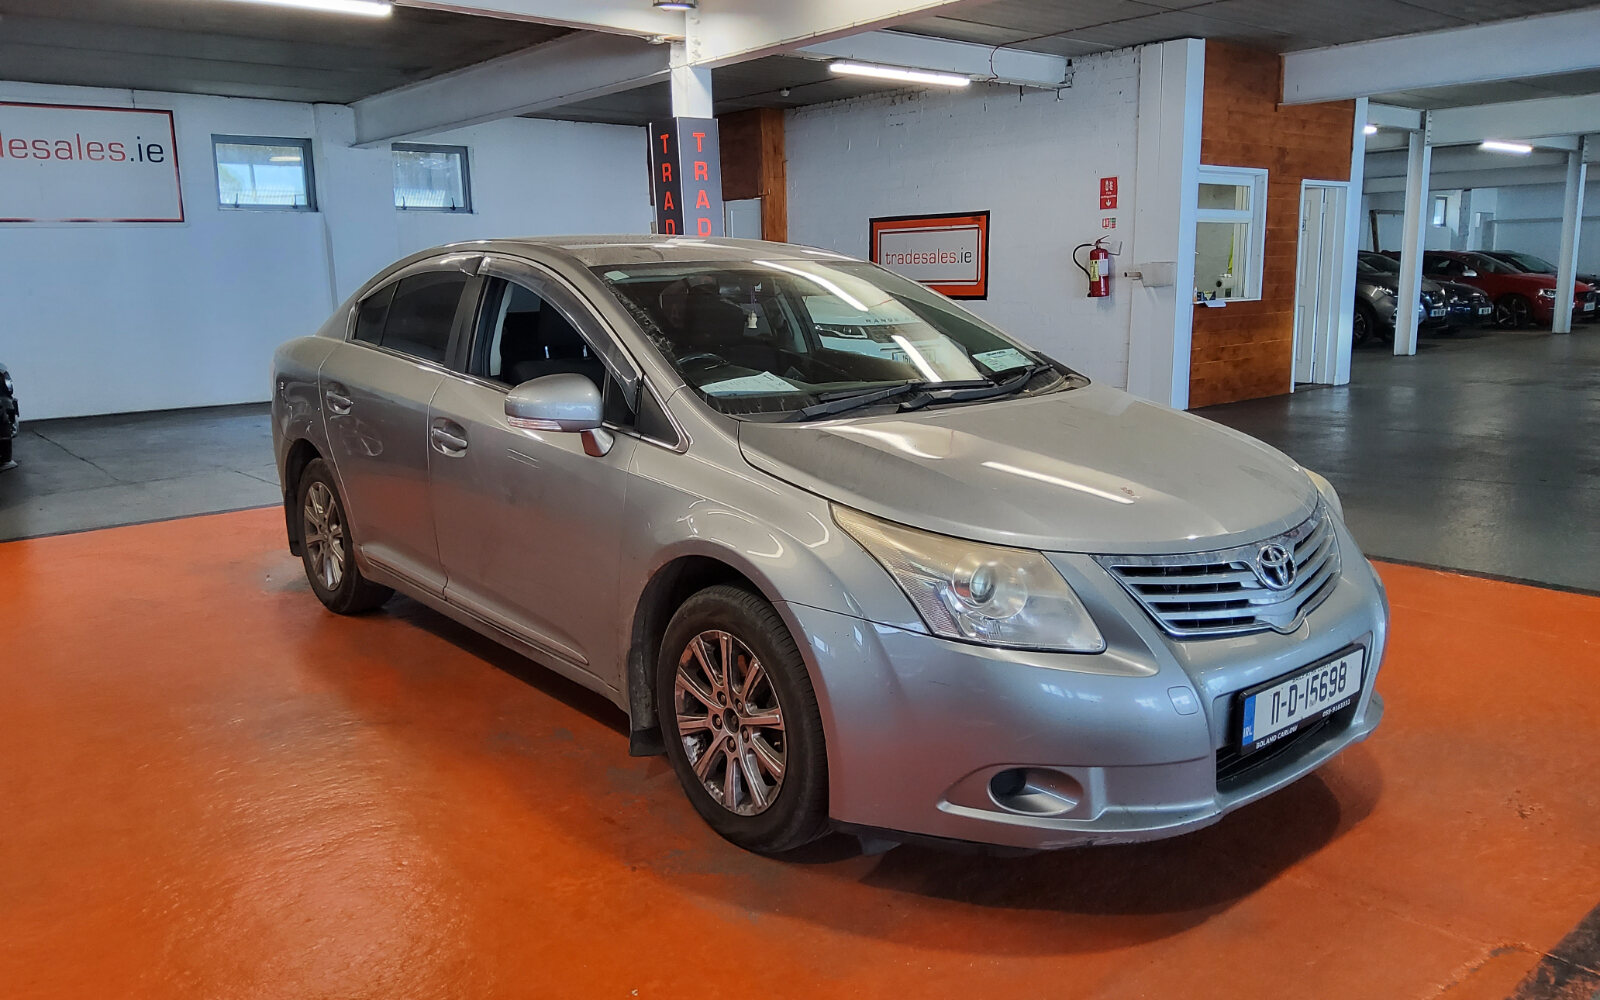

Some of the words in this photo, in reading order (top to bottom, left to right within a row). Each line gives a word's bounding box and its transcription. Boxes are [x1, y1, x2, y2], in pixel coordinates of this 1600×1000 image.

[660, 133, 676, 235] TRAD
[692, 132, 712, 237] TRAD
[885, 247, 972, 265] tradesales.ie
[1243, 726, 1252, 738] IRL
